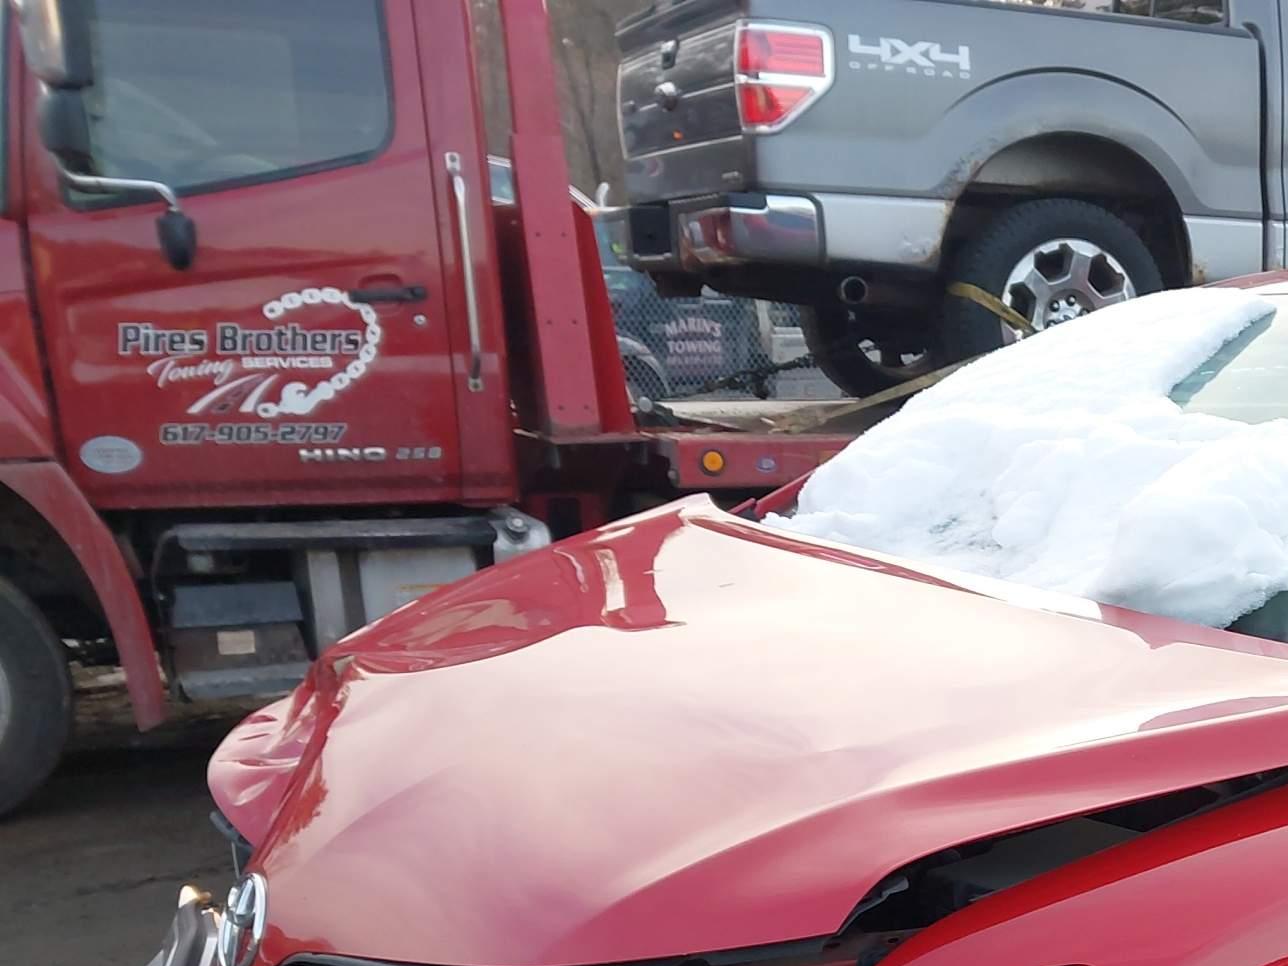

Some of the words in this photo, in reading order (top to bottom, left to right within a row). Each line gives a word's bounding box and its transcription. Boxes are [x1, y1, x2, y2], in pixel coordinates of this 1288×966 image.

[848, 34, 970, 70] 4X4
[118, 323, 207, 355] Pires
[216, 323, 361, 355] Brothers
[666, 340, 721, 353] TOWING
[147, 353, 233, 388] Towing
[242, 356, 333, 369] SERVICES
[160, 423, 347, 445] 617-905-2797
[298, 447, 386, 462] HINO
